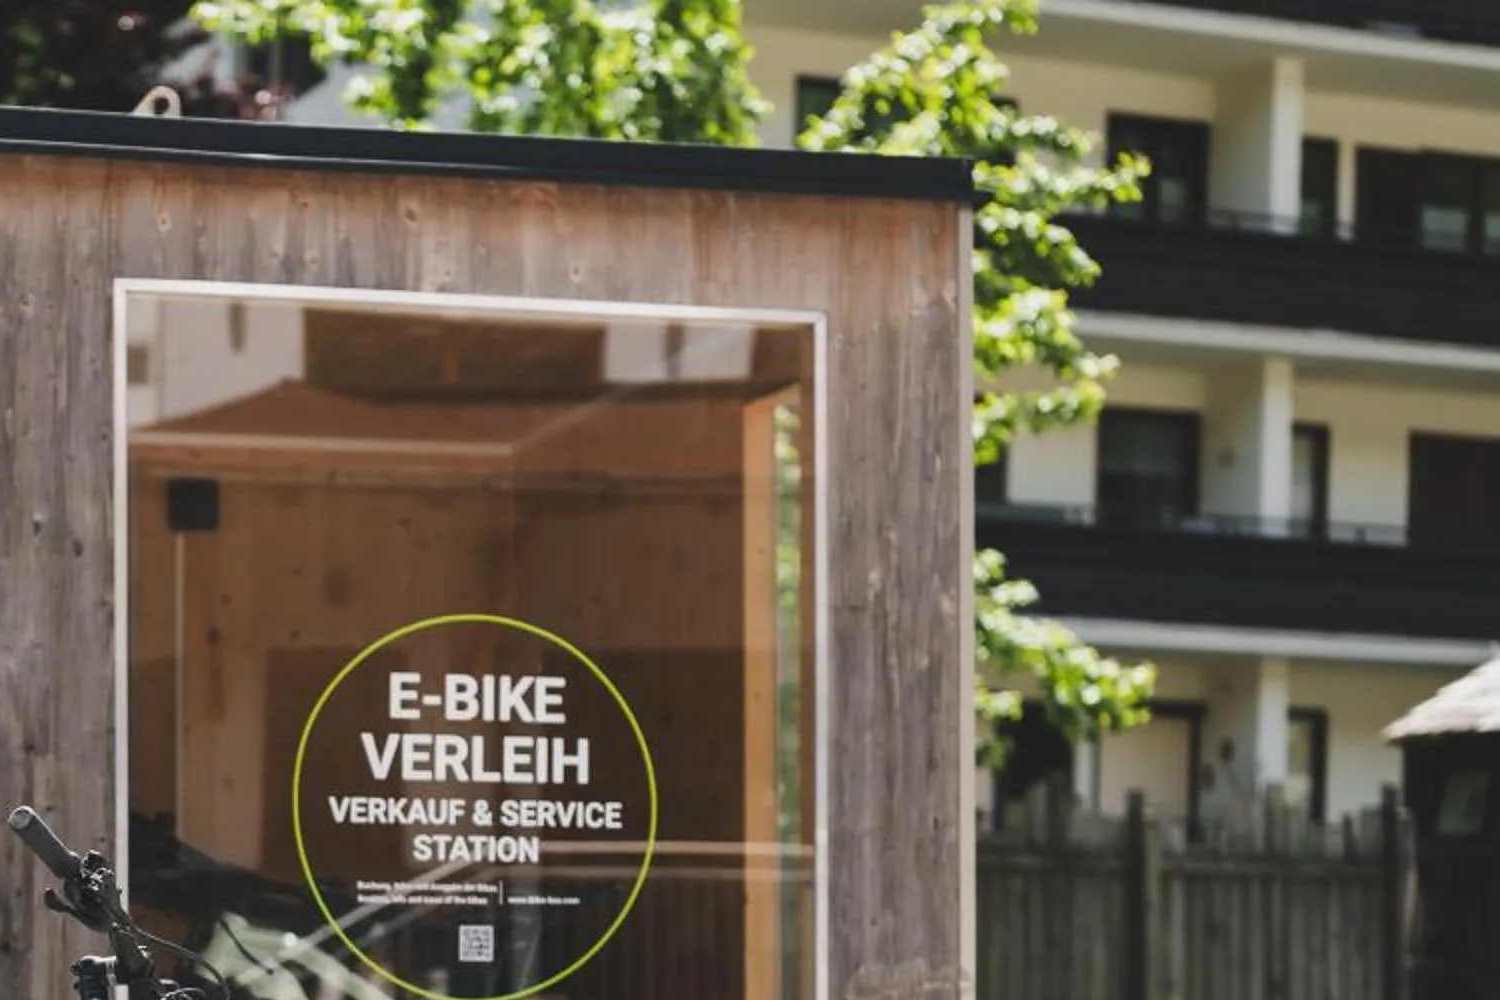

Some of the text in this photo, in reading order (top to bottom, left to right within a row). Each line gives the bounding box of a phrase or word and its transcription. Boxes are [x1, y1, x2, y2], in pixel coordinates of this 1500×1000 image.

[389, 672, 567, 725] E-BIKE
[360, 732, 590, 785] VERLEIH
[328, 796, 624, 830] VERKAUF & SERVICE
[412, 834, 541, 865] STATION
